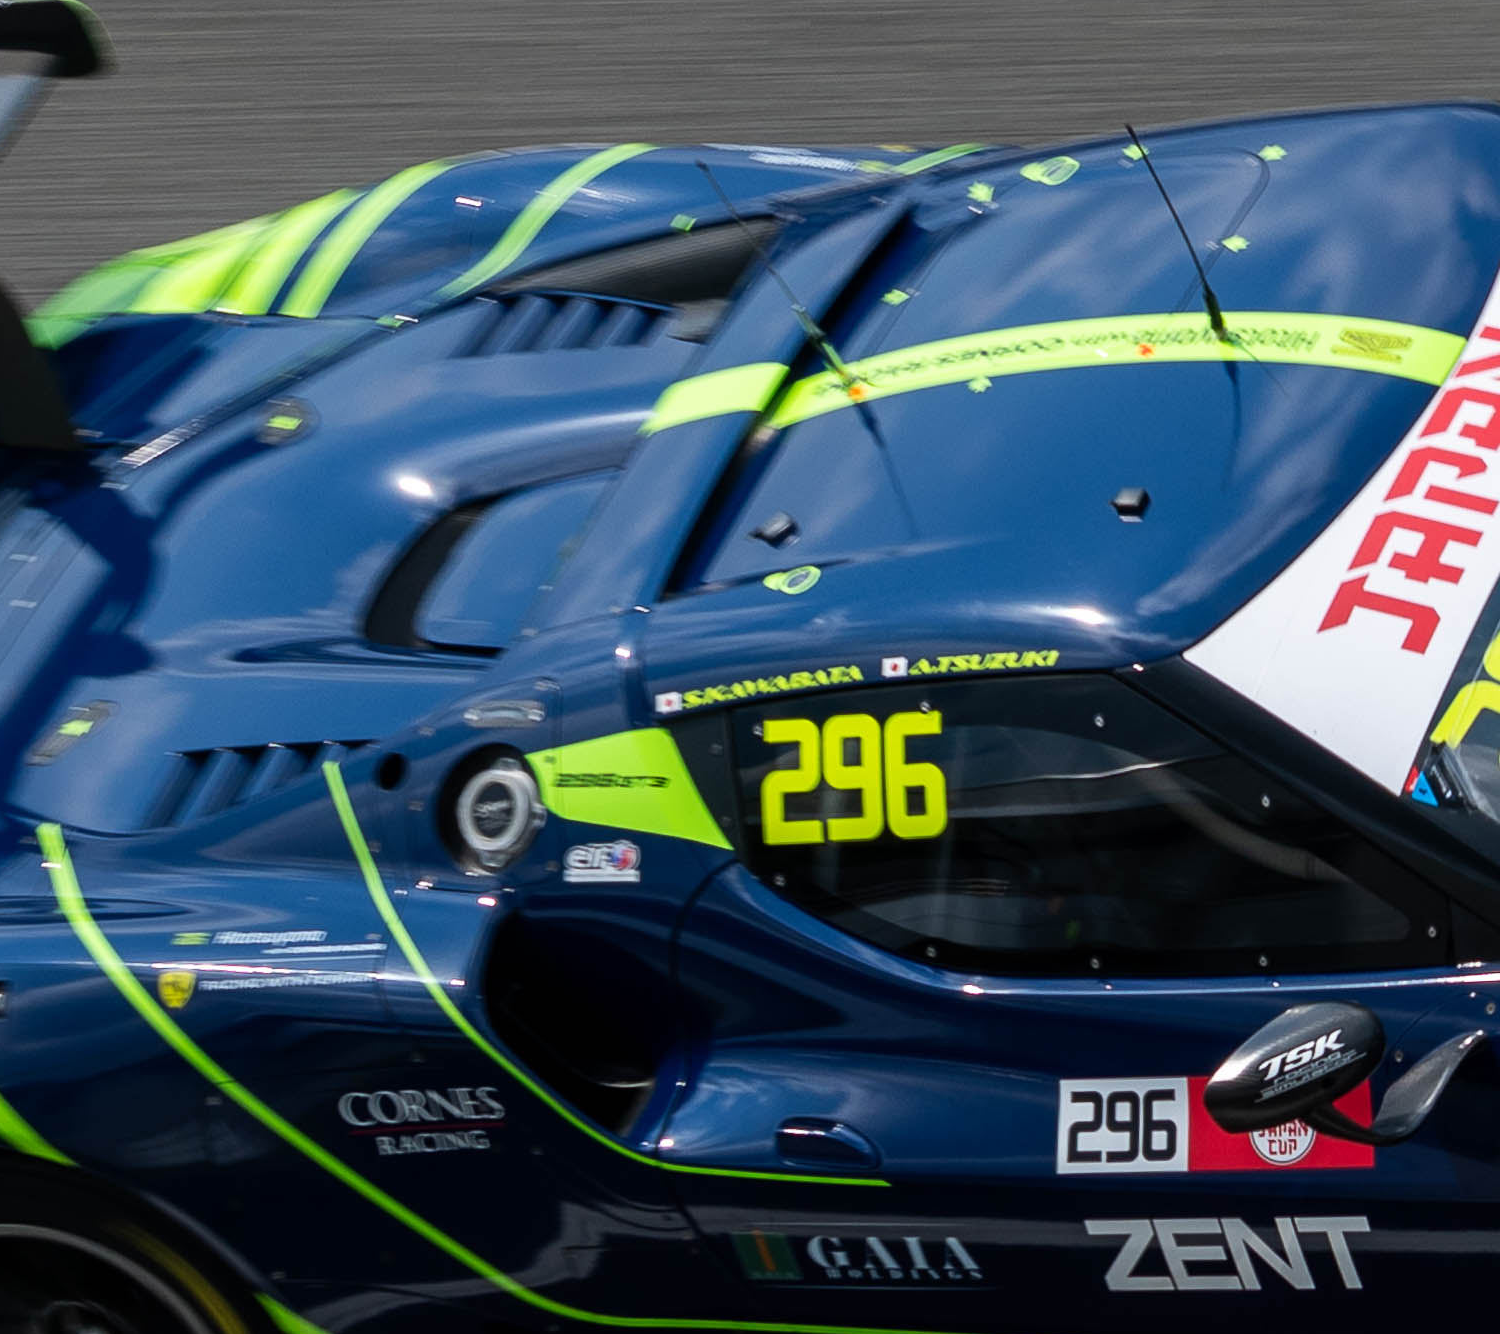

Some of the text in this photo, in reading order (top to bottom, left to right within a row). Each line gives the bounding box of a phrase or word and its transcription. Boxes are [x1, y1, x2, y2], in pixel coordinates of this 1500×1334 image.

[760, 710, 948, 846] 296
[1258, 1028, 1346, 1082] TSK
[337, 1086, 506, 1127] CORNES
[1066, 1088, 1178, 1164] 296
[375, 1129, 491, 1156] RACING
[1268, 1138, 1298, 1156] CUP
[806, 1234, 980, 1270] GAIA
[1084, 1216, 1371, 1291] ZENT
